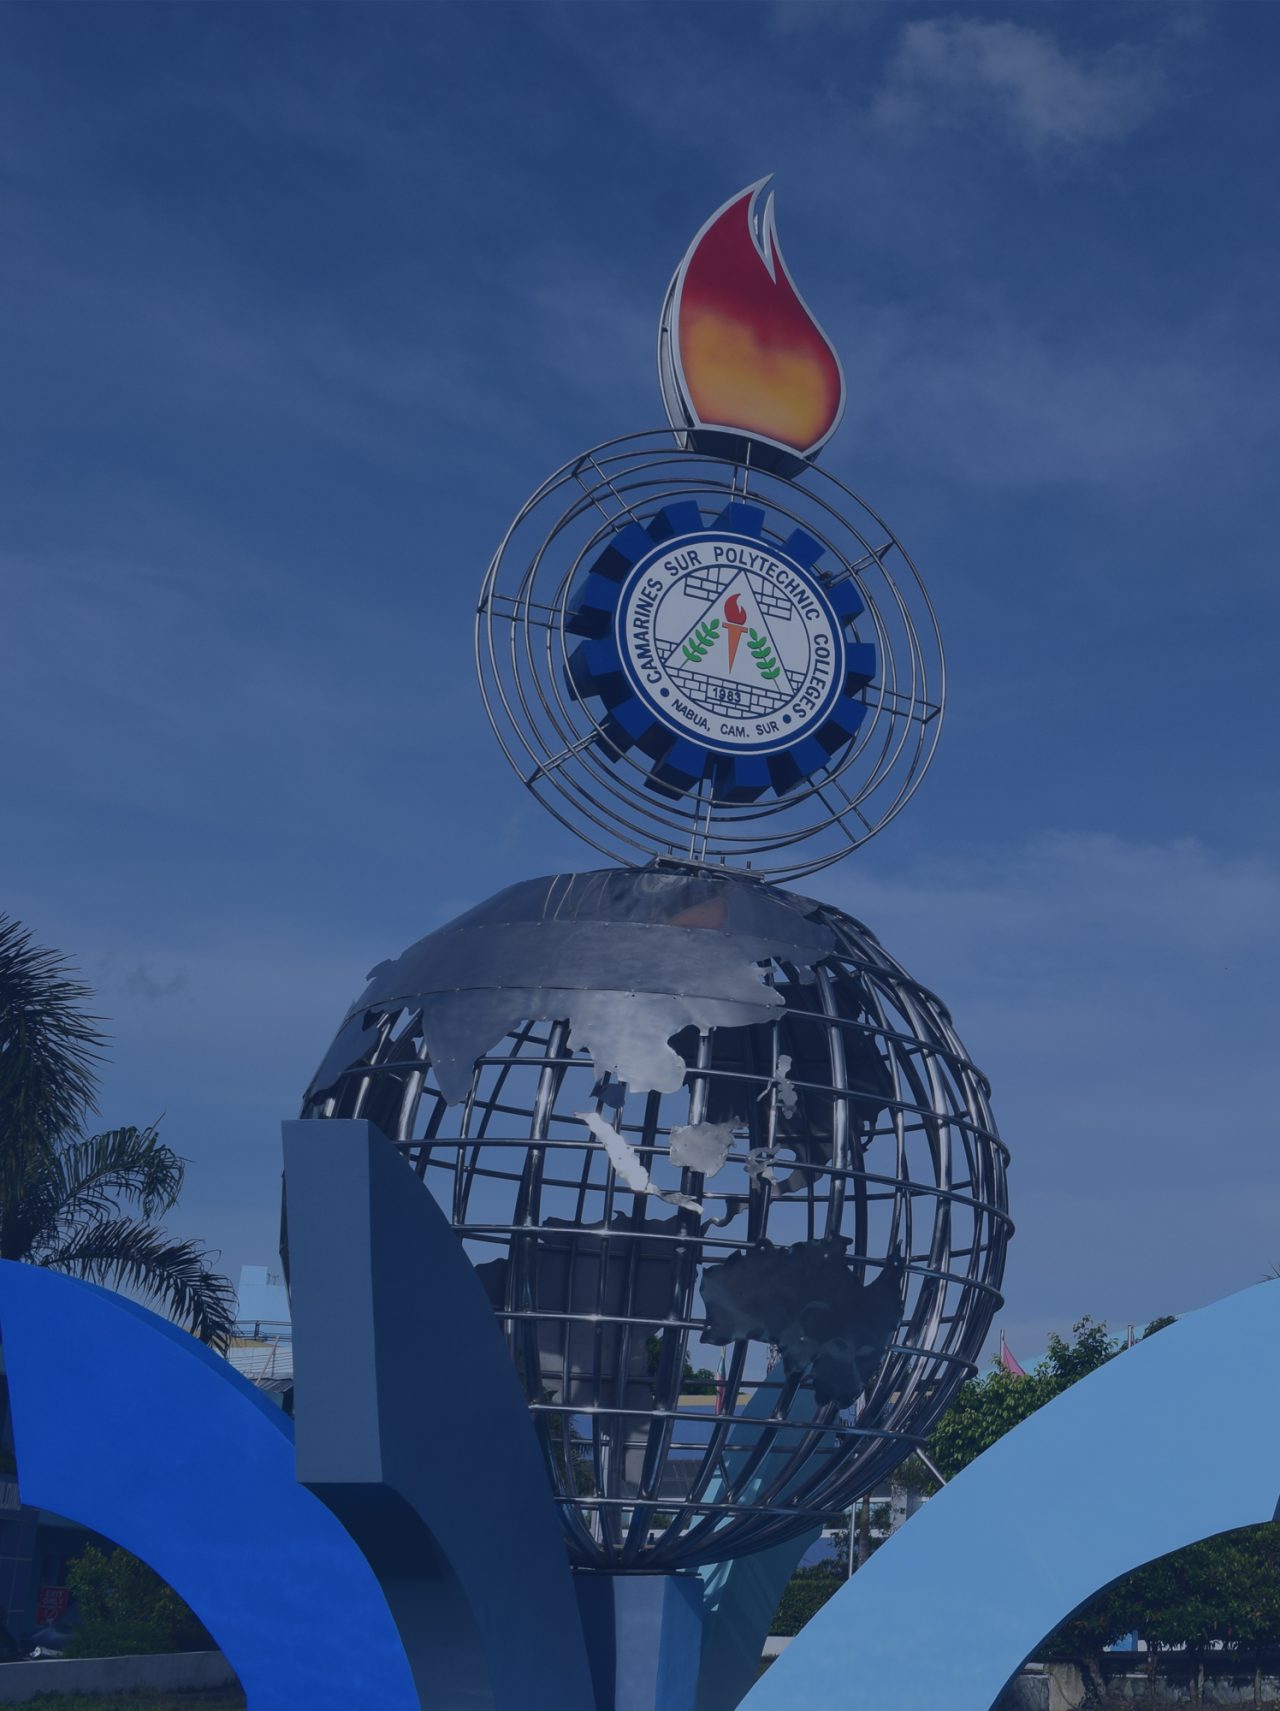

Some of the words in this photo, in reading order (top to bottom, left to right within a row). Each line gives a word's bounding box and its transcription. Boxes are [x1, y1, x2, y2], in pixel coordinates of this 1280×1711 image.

[633, 577, 663, 684] CAMARINES
[664, 550, 702, 576] SUR
[713, 546, 820, 621] POLYTECHNIC
[792, 633, 829, 719] COLLEGES
[712, 687, 741, 703] 1983
[671, 698, 711, 732] NABUA,
[720, 722, 750, 738] CAM.
[756, 721, 780, 736] SUR
